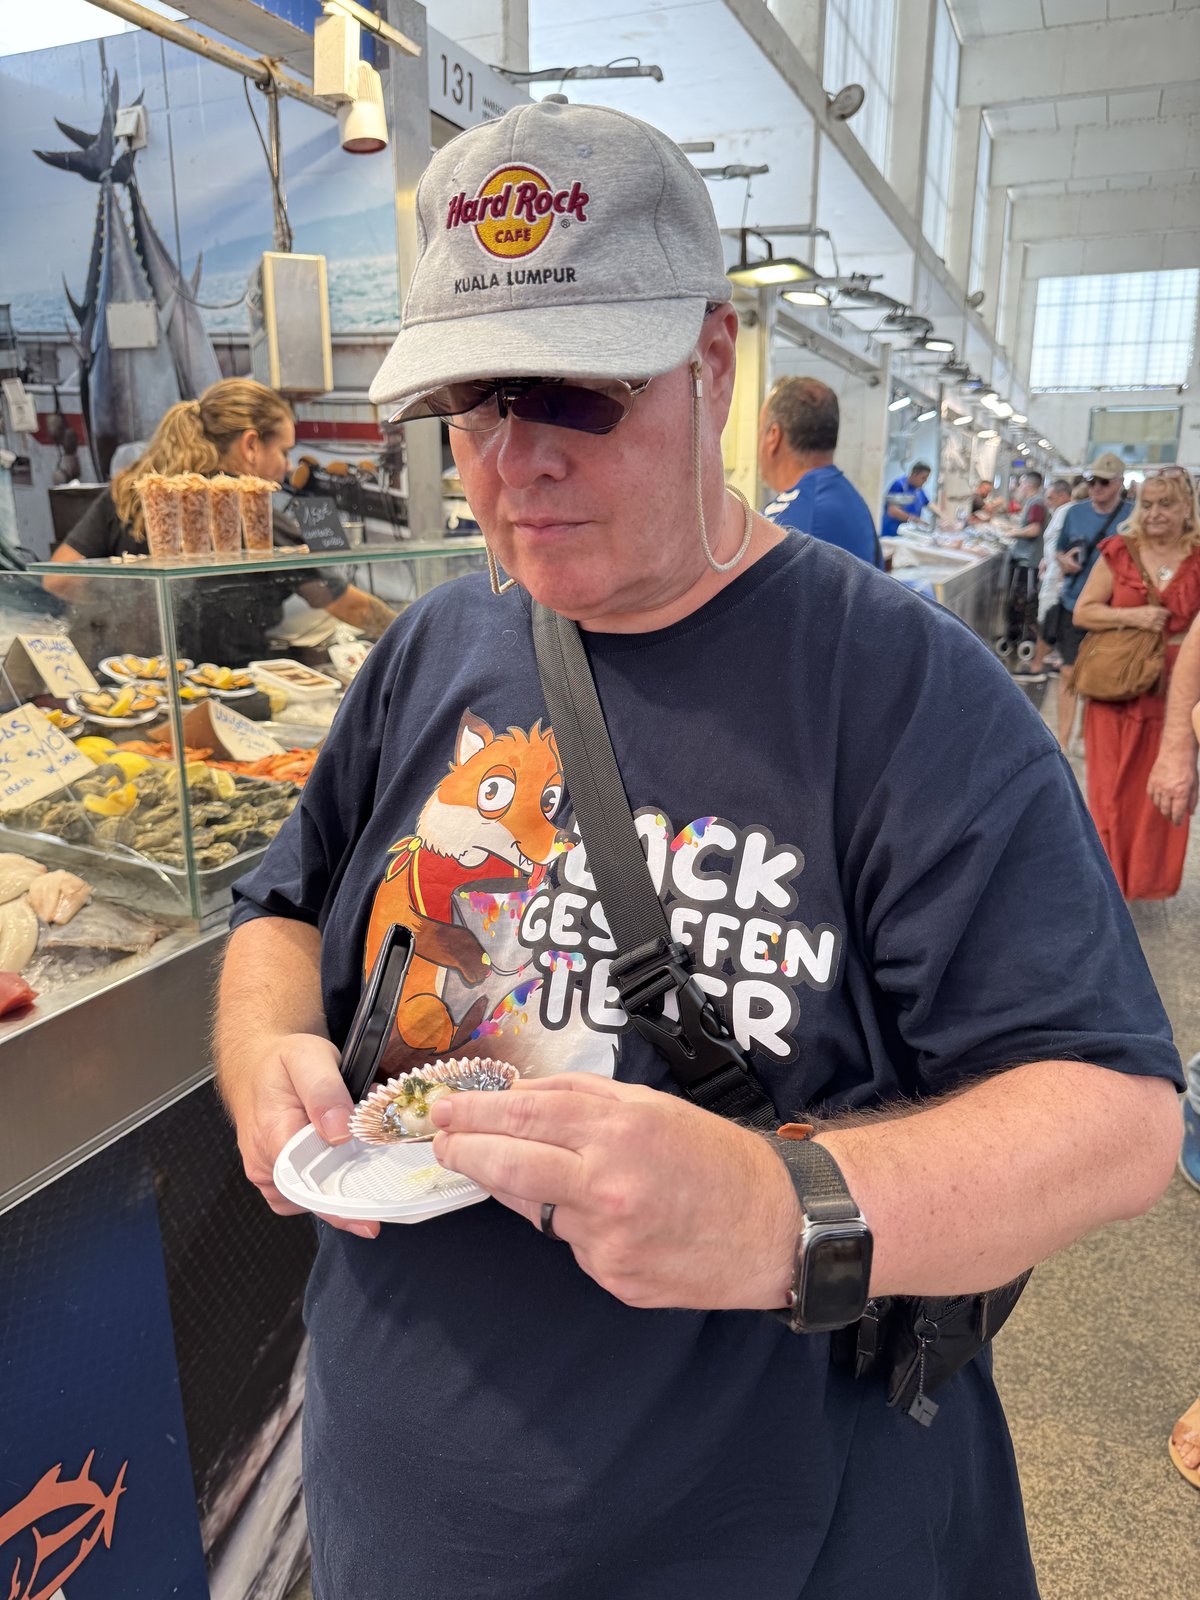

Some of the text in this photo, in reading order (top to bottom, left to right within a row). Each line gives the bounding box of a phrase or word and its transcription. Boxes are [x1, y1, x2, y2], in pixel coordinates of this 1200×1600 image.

[440, 53, 473, 113] 131
[446, 181, 590, 229] Hard Rock
[494, 227, 531, 243] CAFE
[454, 267, 577, 294] KUALA LUMPUR
[521, 892, 835, 984] GESFFEN
